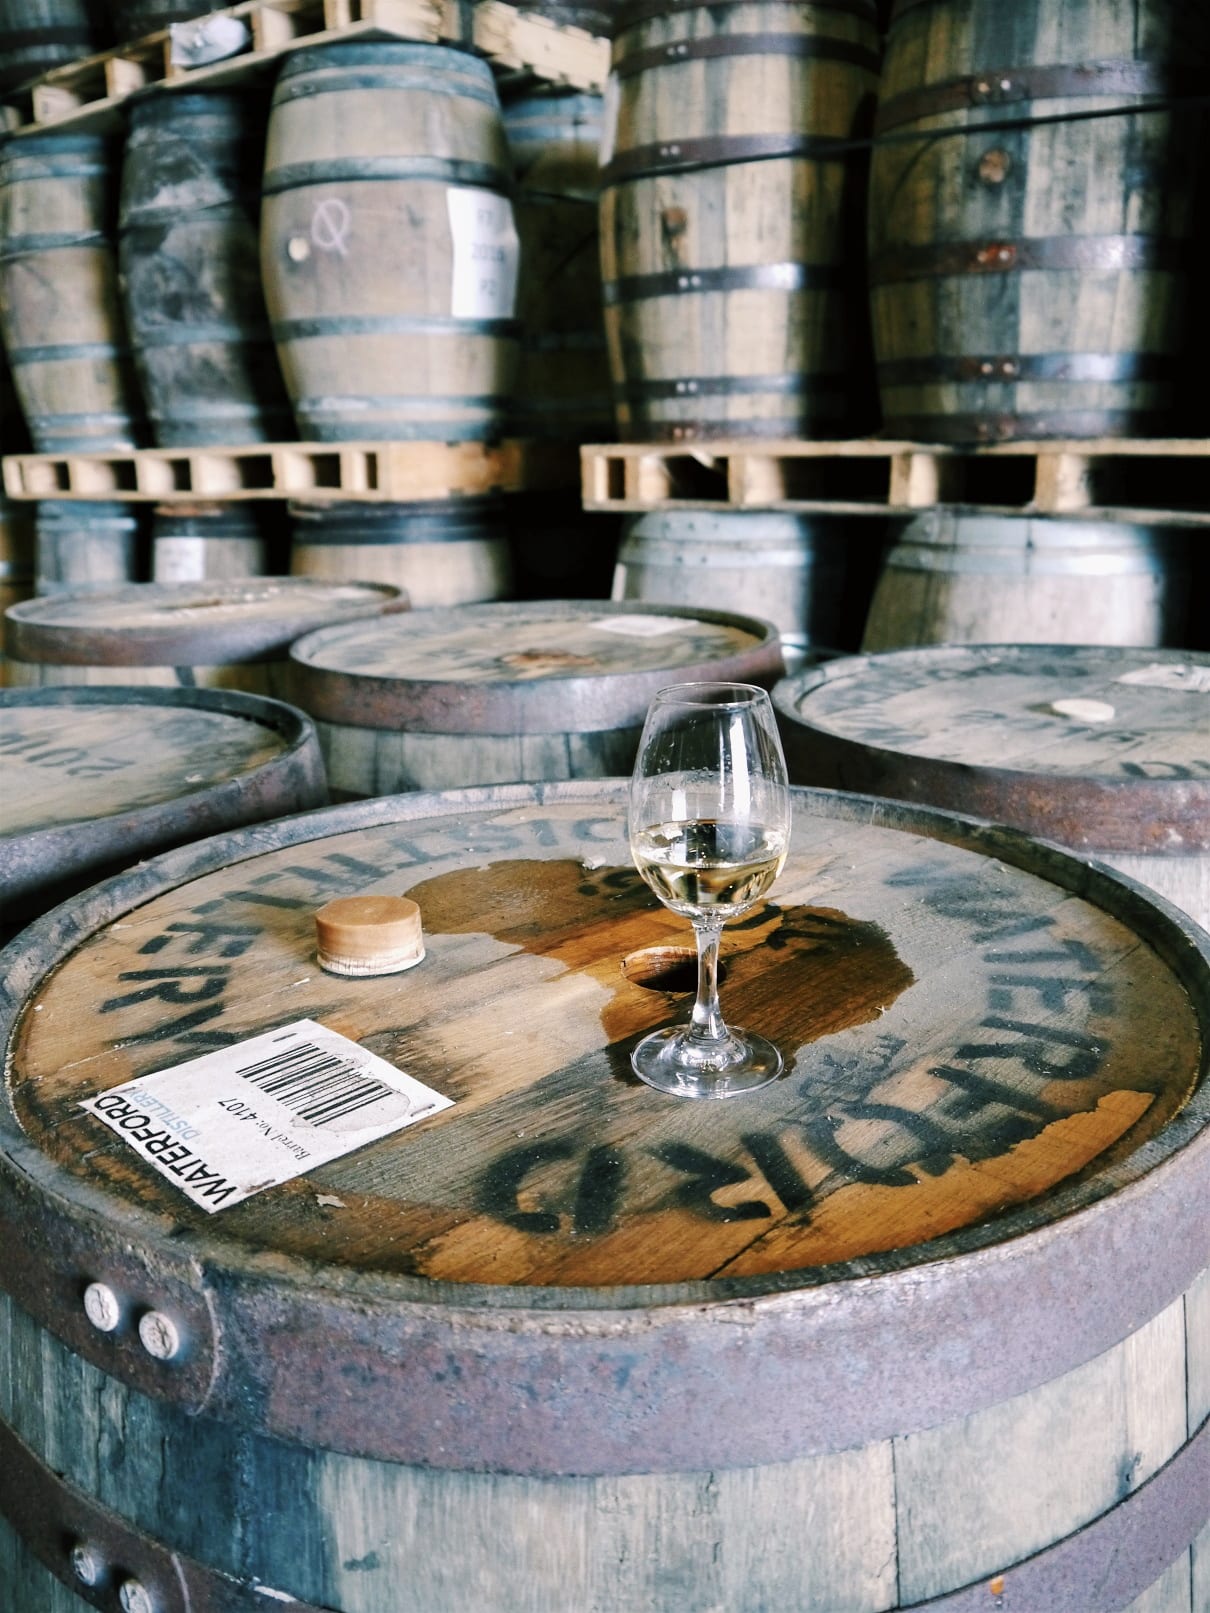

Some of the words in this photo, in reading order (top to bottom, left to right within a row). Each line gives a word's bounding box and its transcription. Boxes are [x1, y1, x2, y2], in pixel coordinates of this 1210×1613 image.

[128, 1089, 203, 1141] DISTILLERY
[217, 1097, 258, 1122] 4107
[93, 1094, 238, 1206] WATERFORD
[269, 1132, 312, 1161] Barrel
